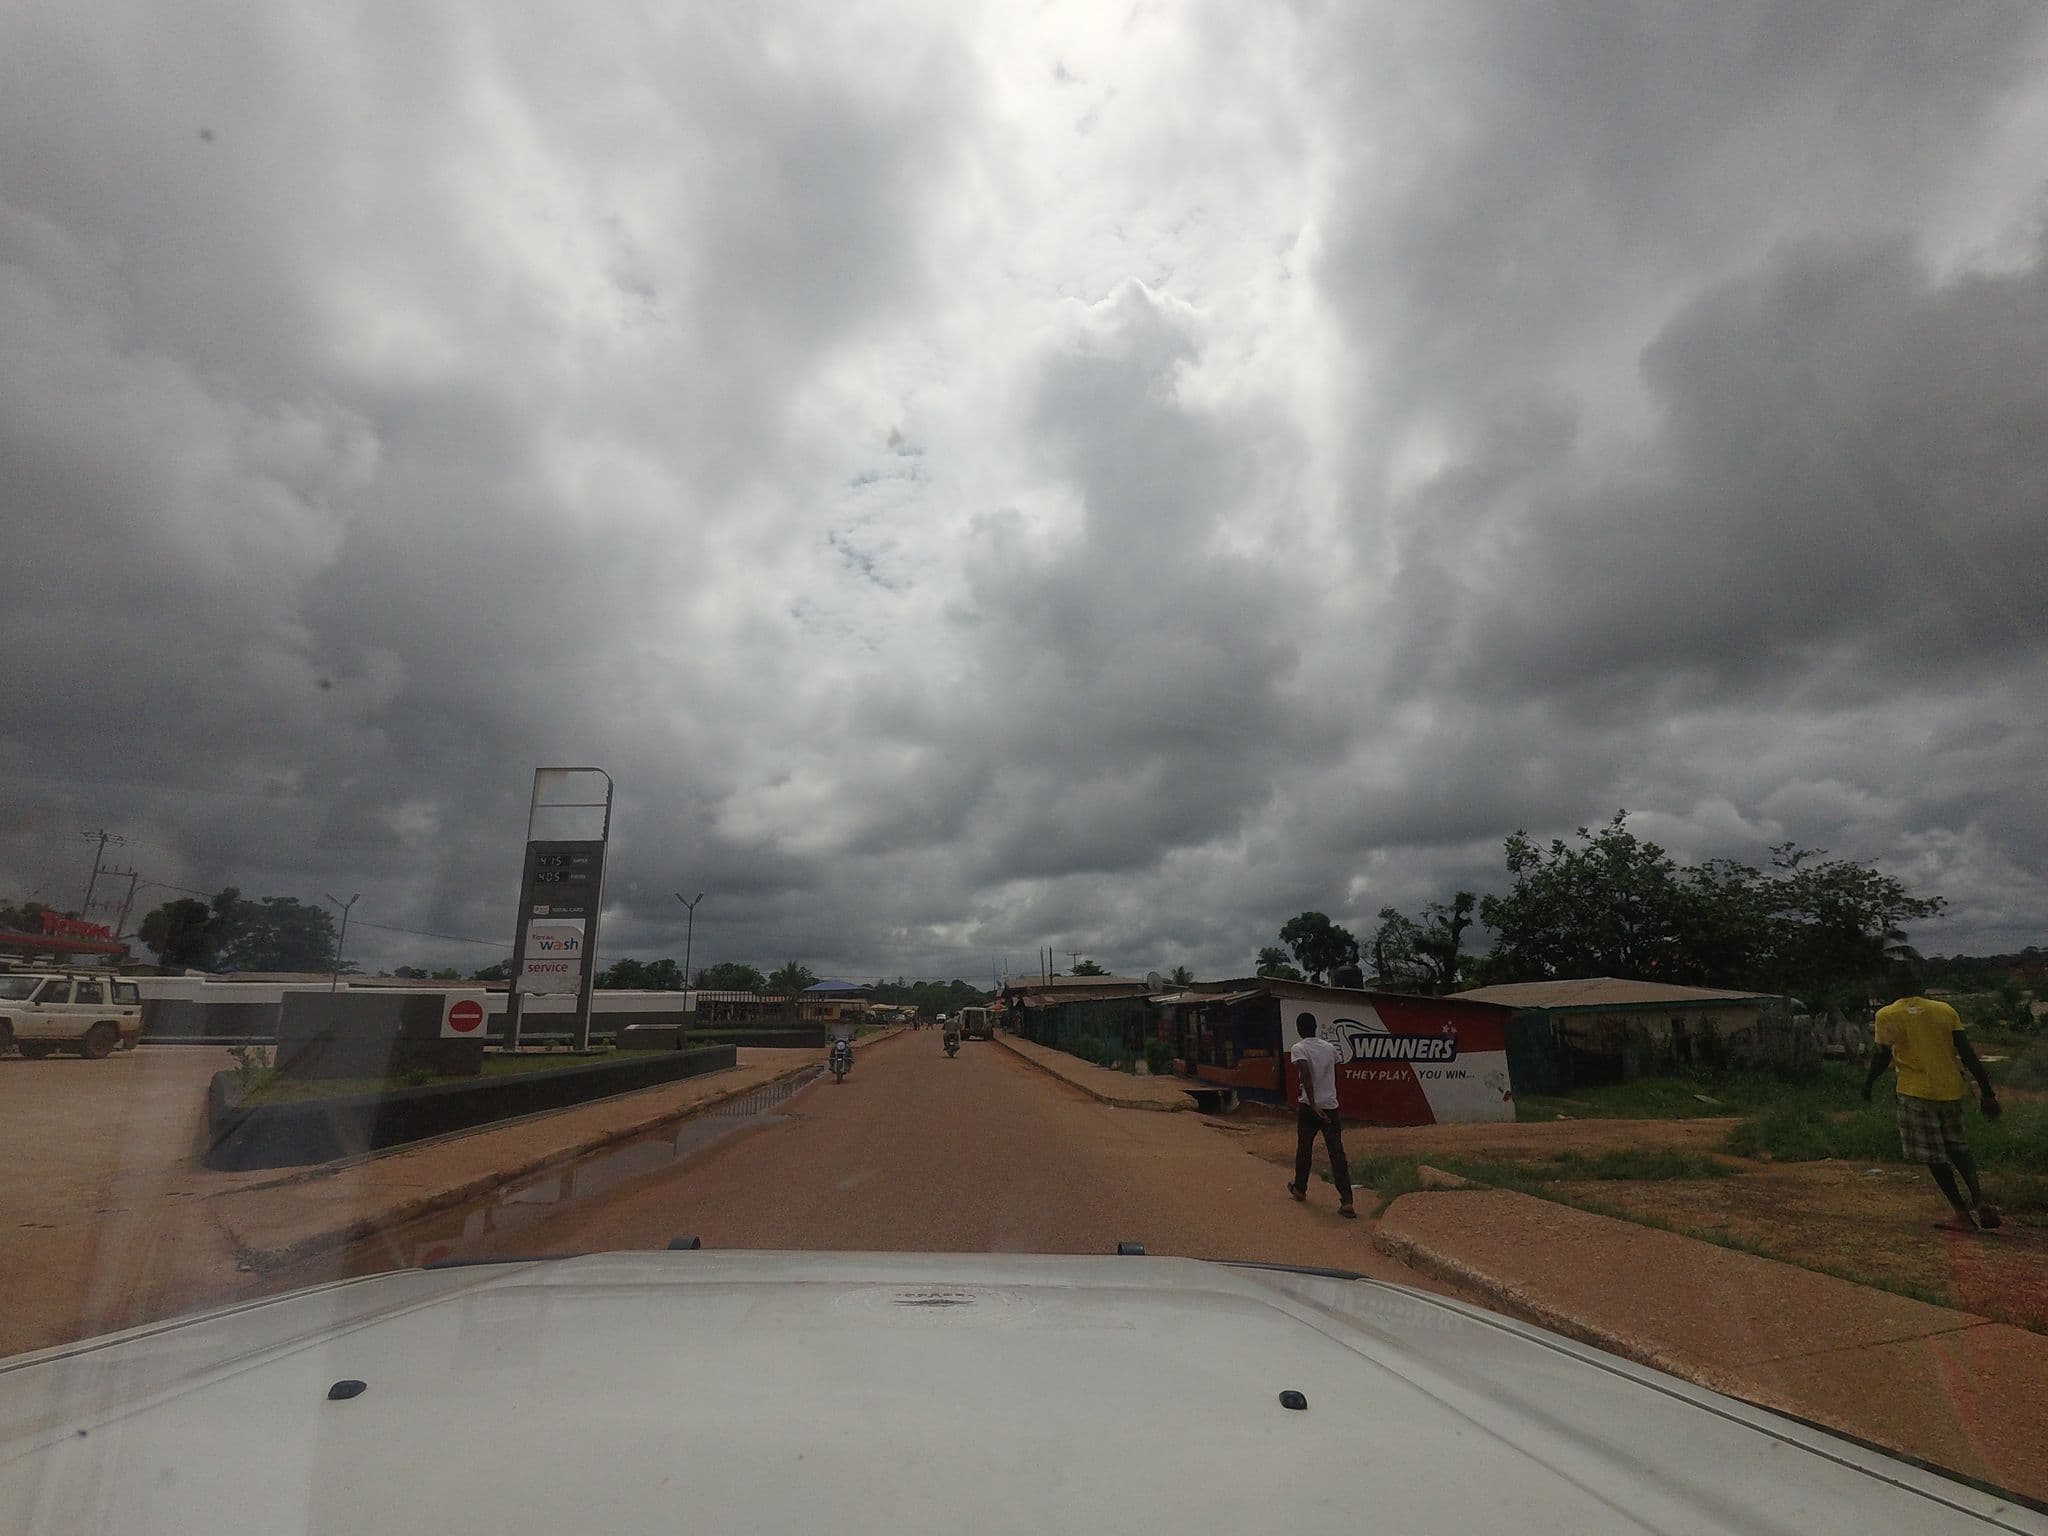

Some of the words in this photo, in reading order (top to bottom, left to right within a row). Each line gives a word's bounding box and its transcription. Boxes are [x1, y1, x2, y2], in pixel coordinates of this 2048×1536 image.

[540, 937, 579, 951] wash
[527, 961, 569, 973] service
[1353, 1038, 1455, 1059] WINNERS
[1345, 1069, 1379, 1080] THEY
[1379, 1069, 1411, 1082] PLAY,
[1419, 1070, 1443, 1080] YOU
